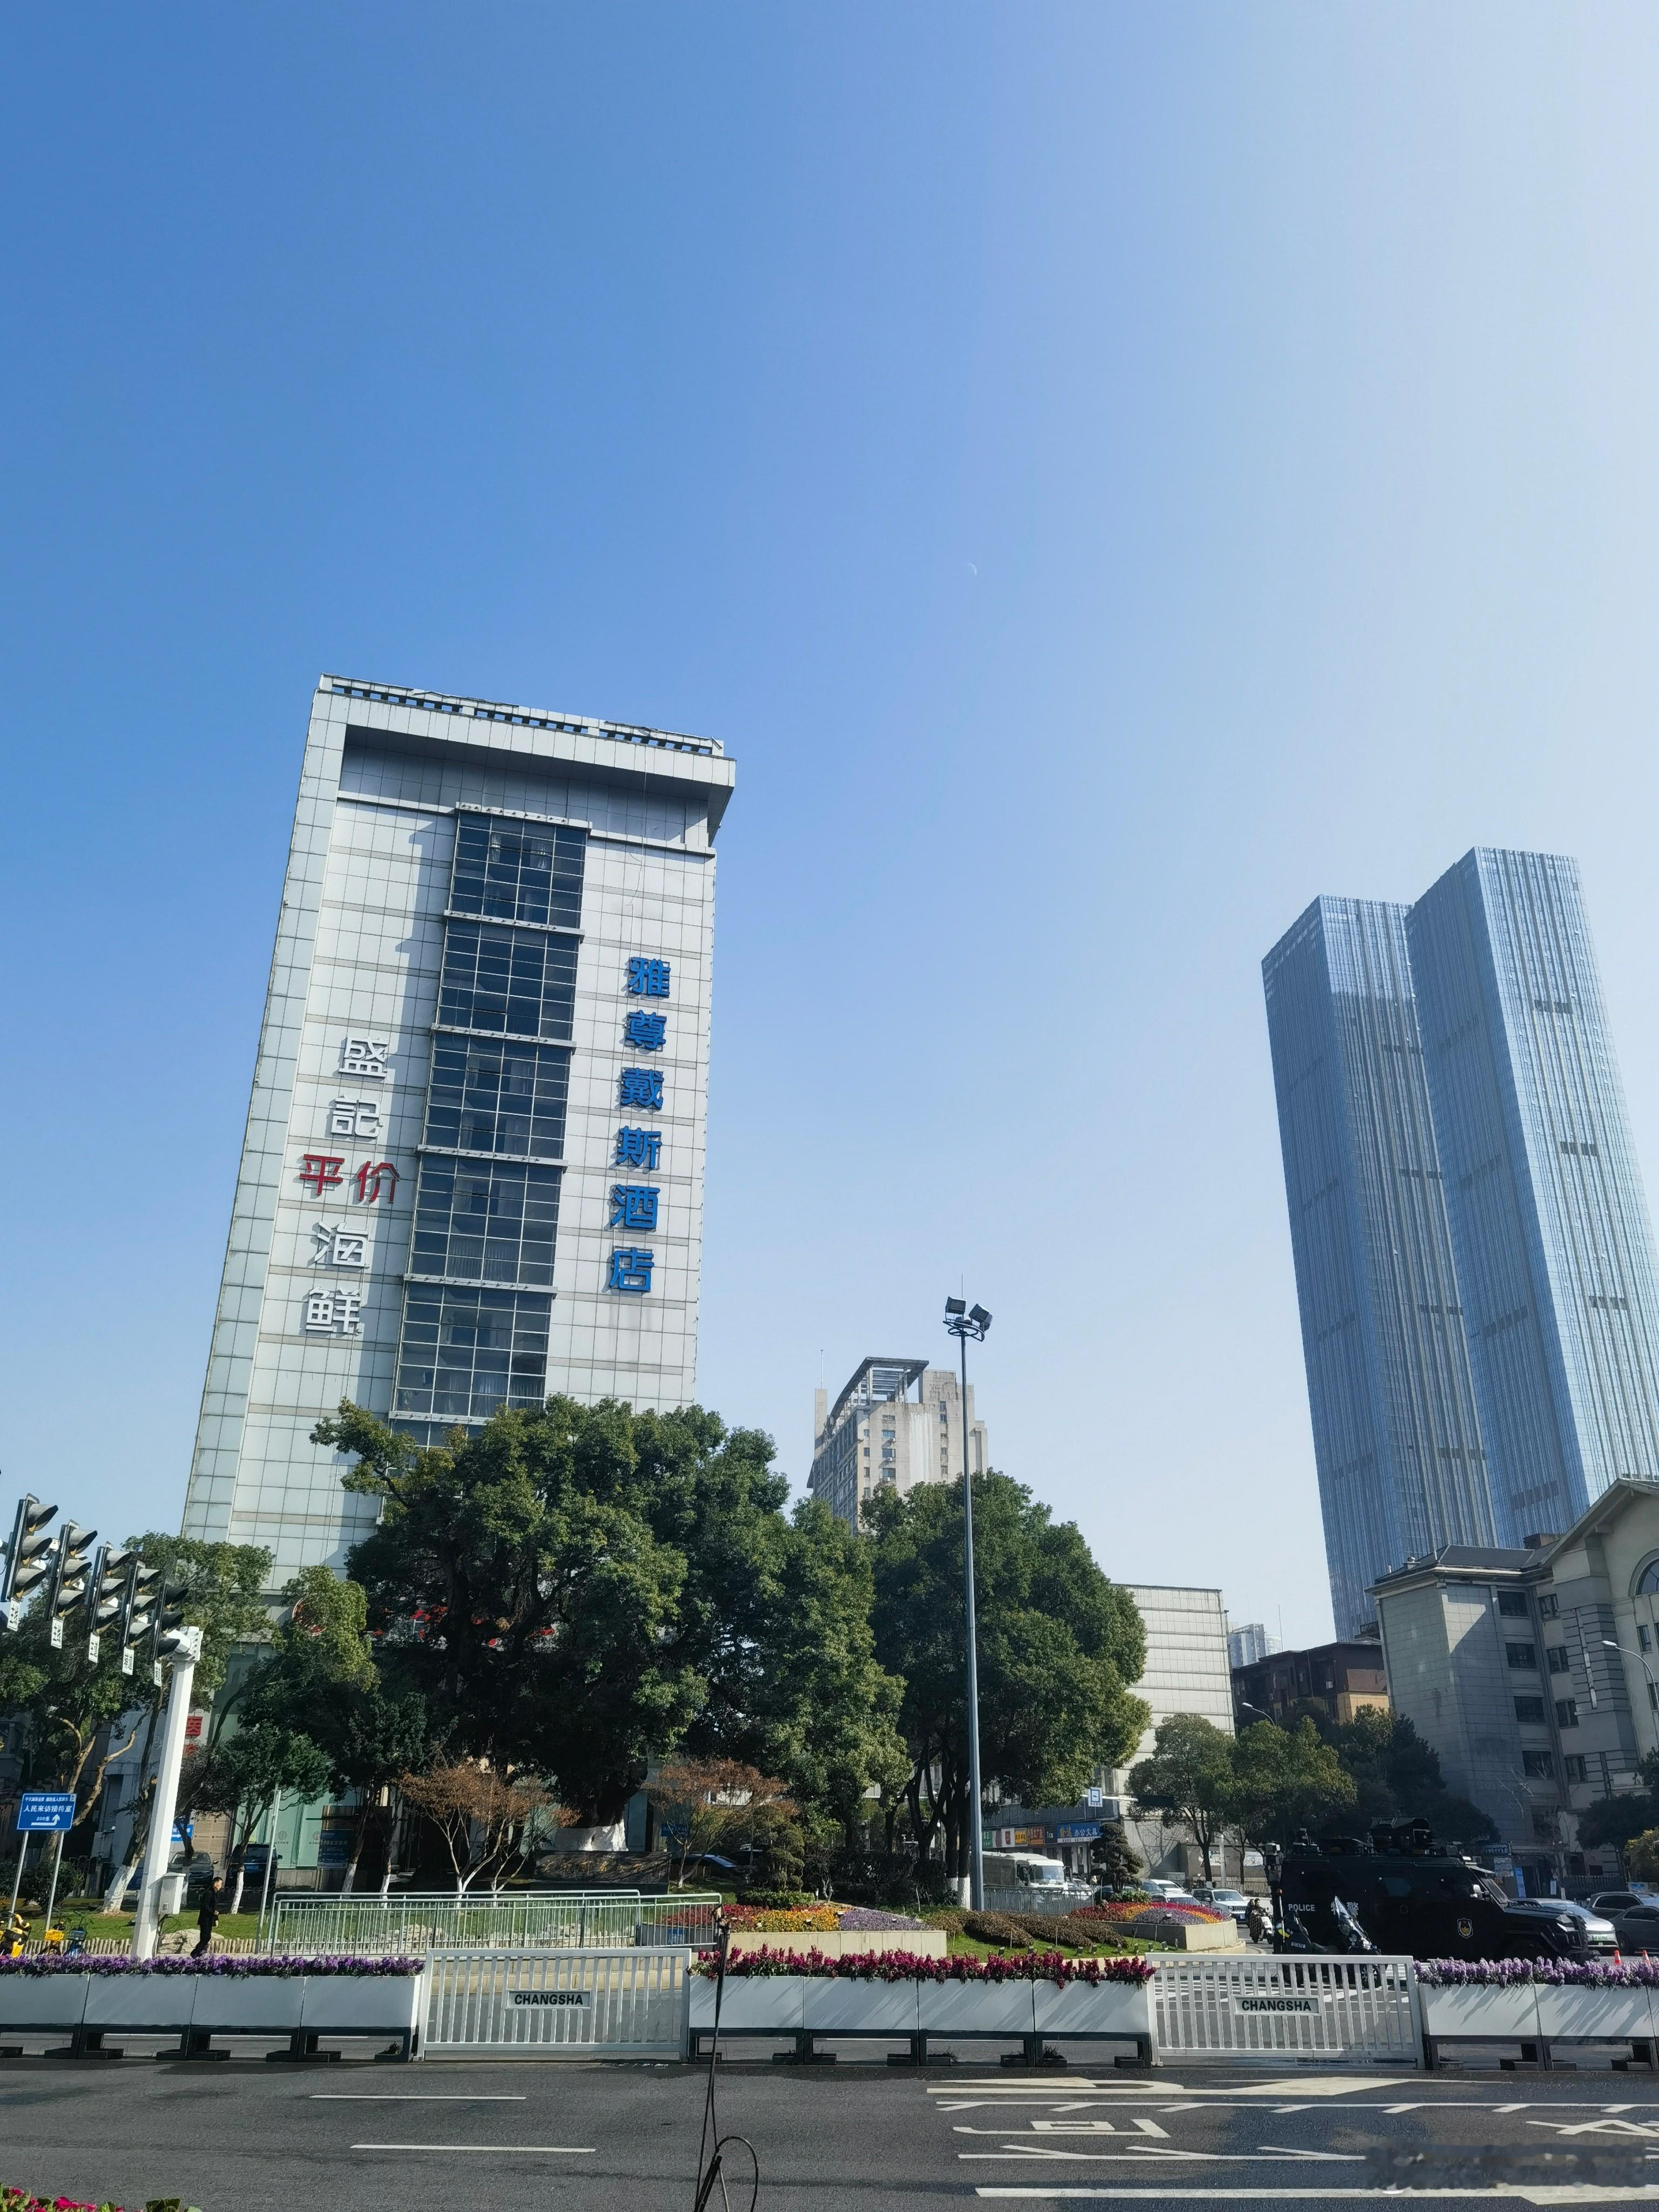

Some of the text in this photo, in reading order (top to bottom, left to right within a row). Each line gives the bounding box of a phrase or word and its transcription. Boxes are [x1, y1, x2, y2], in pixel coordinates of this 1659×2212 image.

[609, 956, 671, 1292] 雅尊戴斯酒店
[299, 1154, 401, 1203] 平价
[23, 1805, 72, 1813] 人民来访接待室
[1074, 1827, 1098, 1837] 办公文具
[1288, 1904, 1316, 1912] POLICE
[515, 1994, 583, 2005] CHANGSHA
[1241, 2000, 1312, 2012] CHANGSHA
